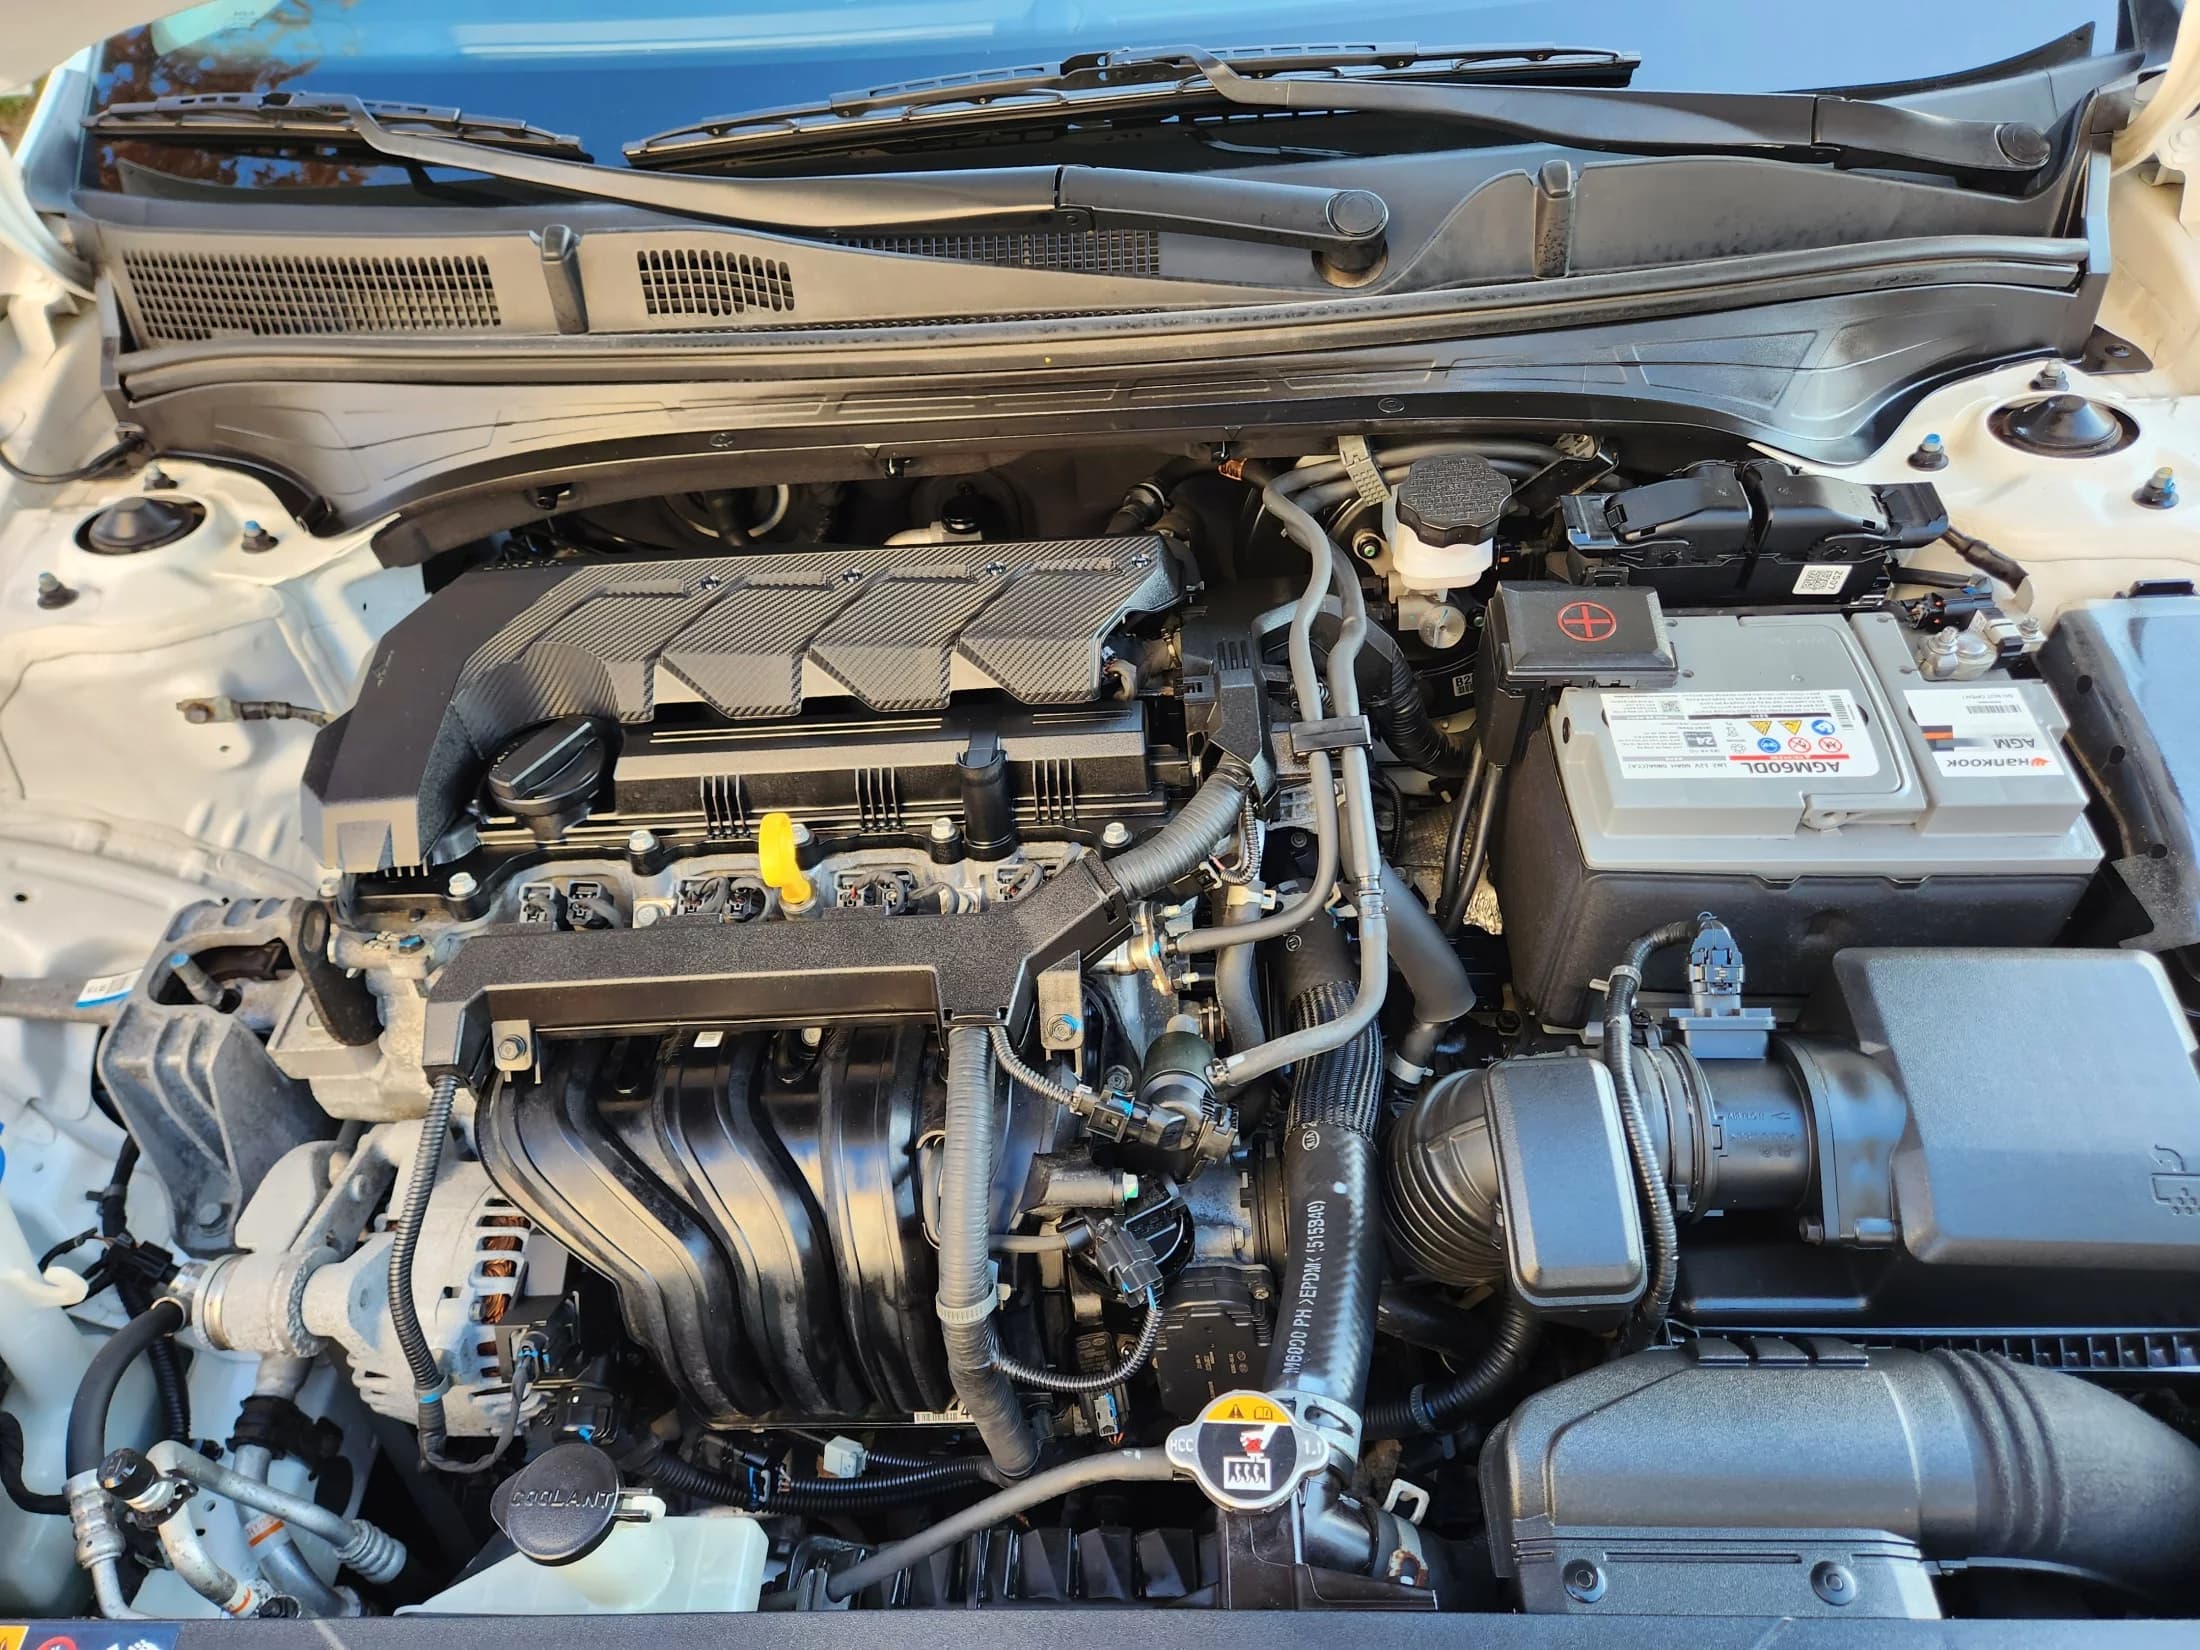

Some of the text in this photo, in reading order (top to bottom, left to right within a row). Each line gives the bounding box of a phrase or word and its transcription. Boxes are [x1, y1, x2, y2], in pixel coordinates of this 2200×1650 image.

[1993, 738, 2036, 749] AGM
[1741, 761, 1841, 775] AGM60DL
[1292, 1309, 1312, 1328] PH
[1170, 1438, 1322, 1456] HCC 1.1
[510, 1488, 615, 1509] COOLANT
